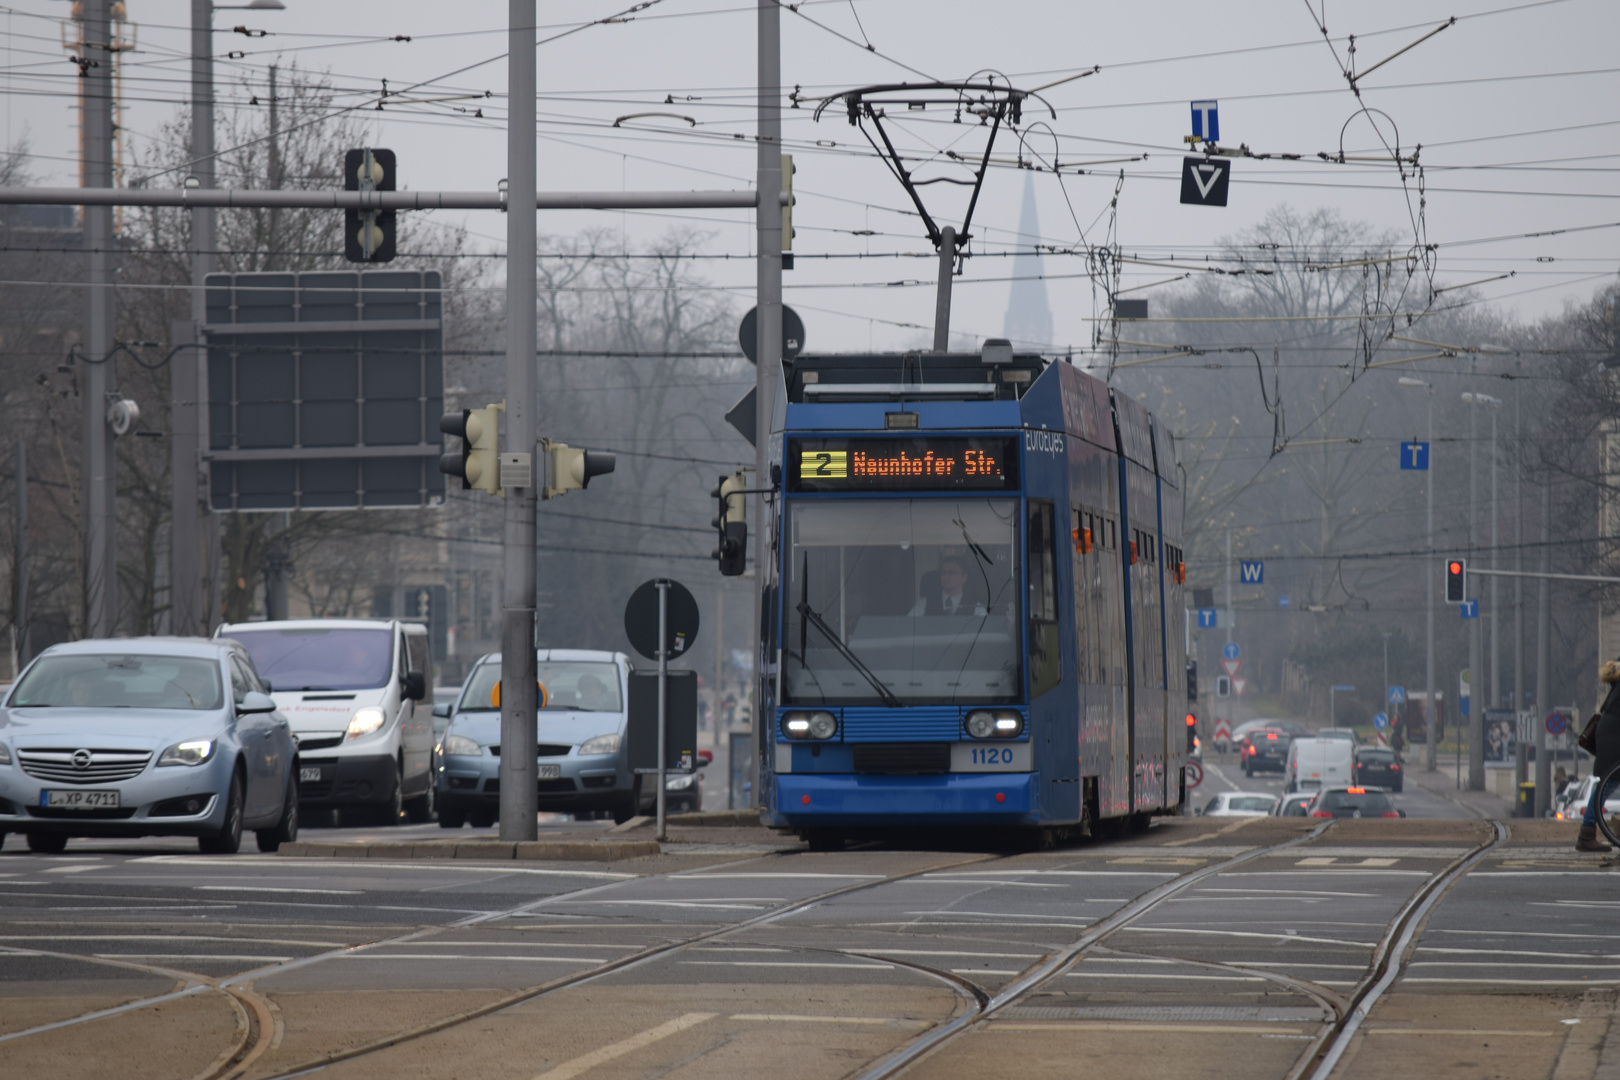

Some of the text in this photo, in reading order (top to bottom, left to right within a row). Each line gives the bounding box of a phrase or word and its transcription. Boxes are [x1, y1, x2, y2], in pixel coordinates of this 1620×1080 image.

[1192, 102, 1217, 139] T
[1023, 422, 1064, 459] EuroEyes
[816, 450, 1001, 476] 2 Naunhofer Str.
[1407, 445, 1423, 467] T
[1243, 563, 1262, 581] W
[1202, 610, 1212, 626] T
[1463, 601, 1474, 617] T
[971, 748, 1013, 764] 1120
[48, 792, 117, 805] L XP 4711
